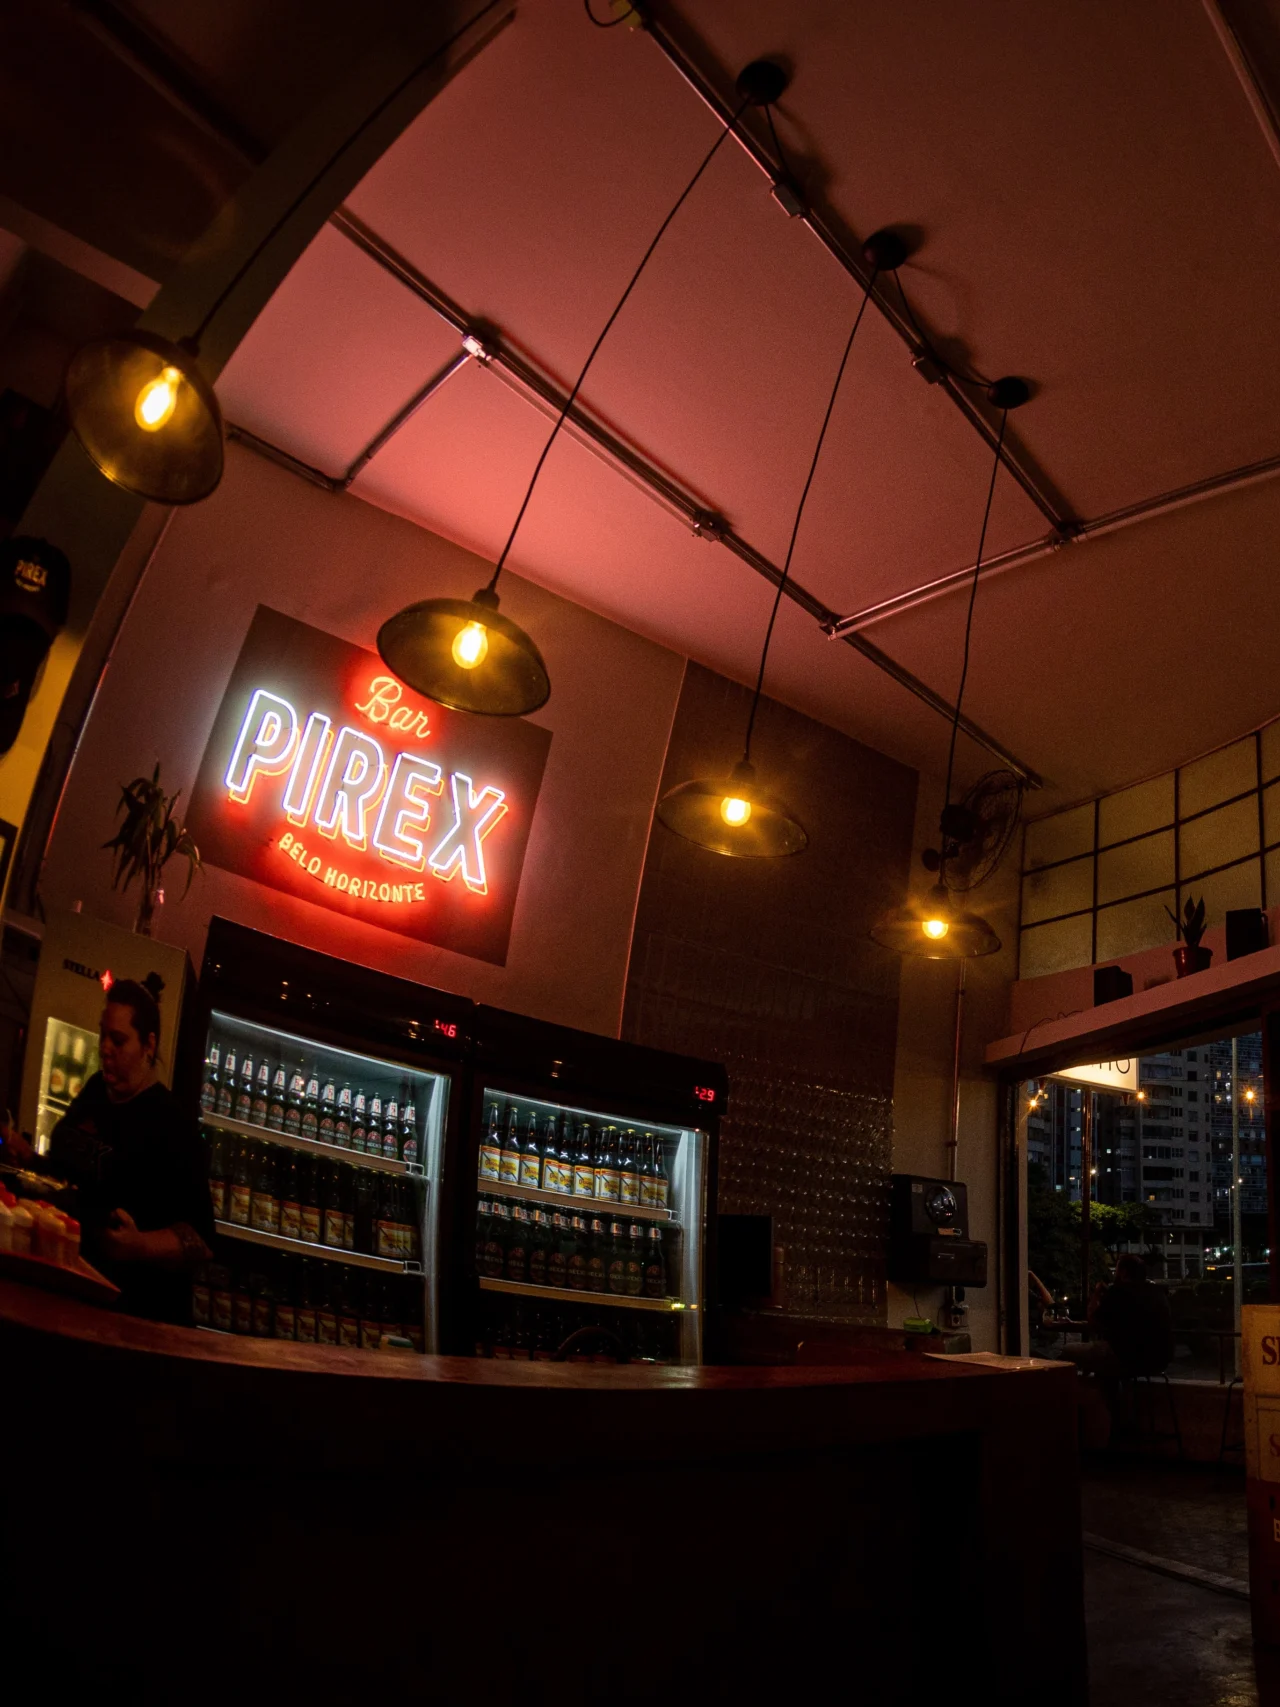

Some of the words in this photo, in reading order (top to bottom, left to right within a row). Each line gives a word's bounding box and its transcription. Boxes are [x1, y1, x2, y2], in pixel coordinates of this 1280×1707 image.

[355, 676, 431, 738] Bar
[224, 688, 508, 894] PIREX
[279, 832, 321, 874] BELO
[325, 867, 426, 902] HORIZONTE
